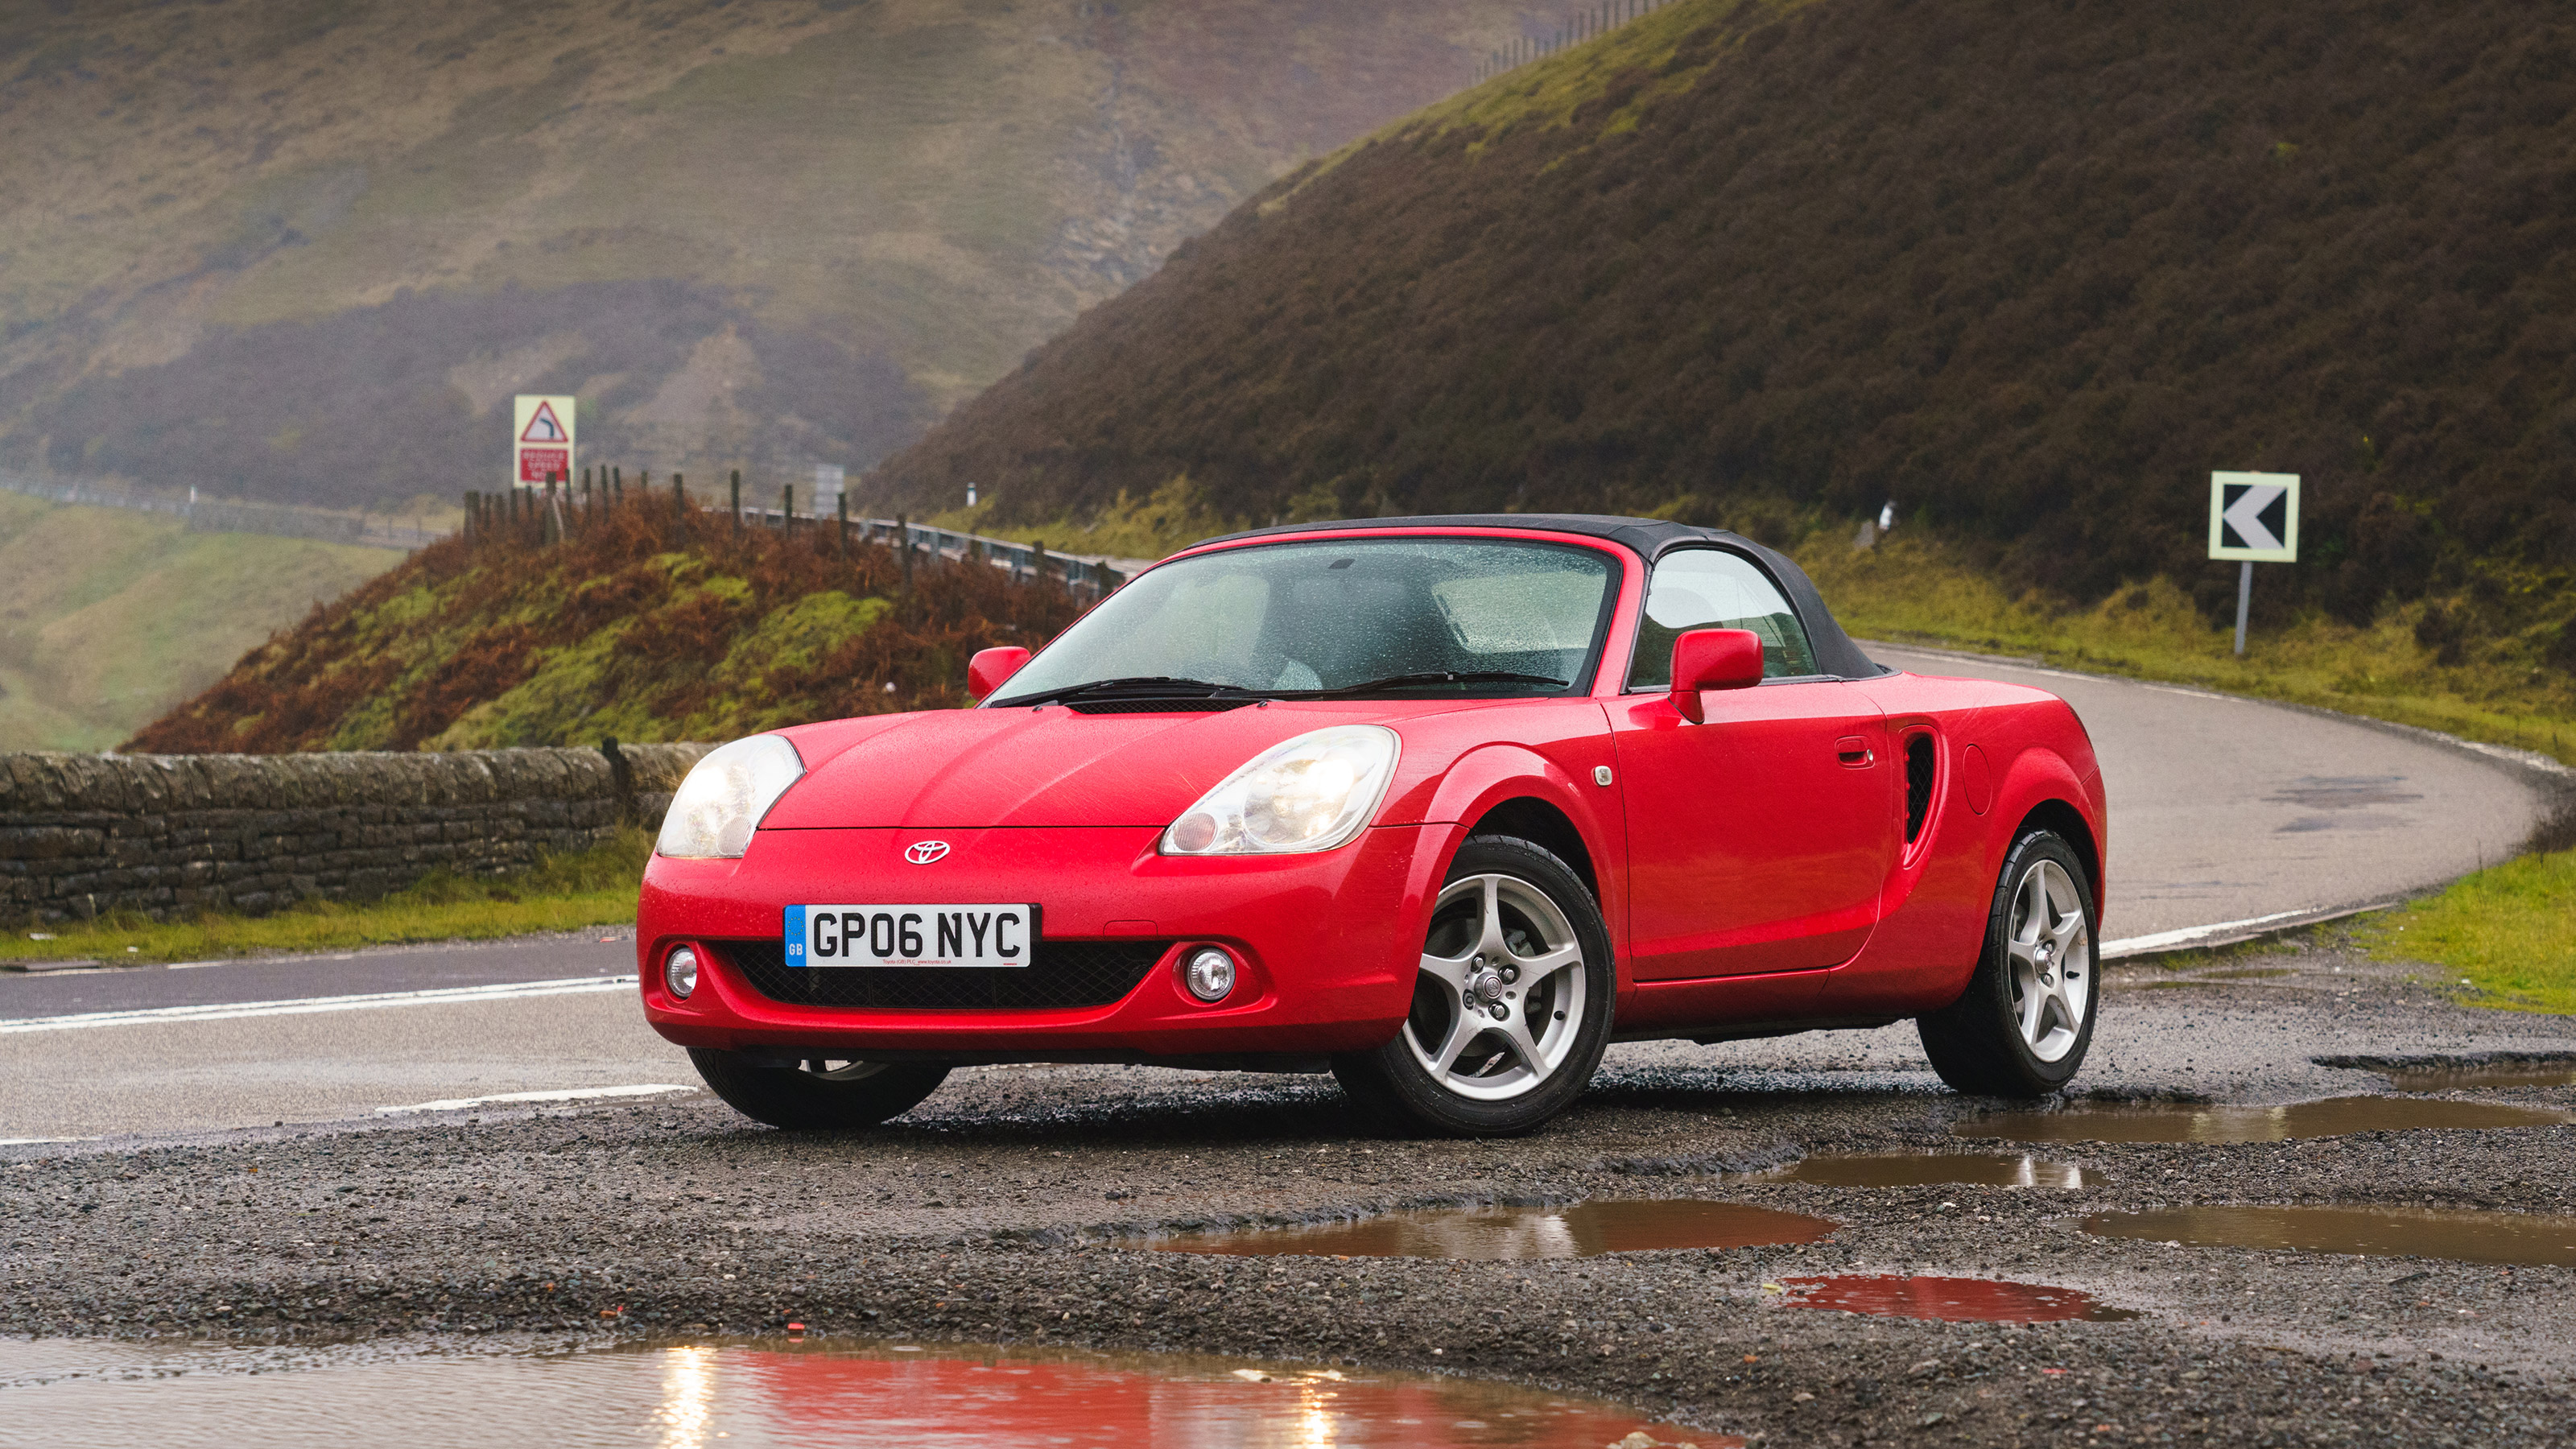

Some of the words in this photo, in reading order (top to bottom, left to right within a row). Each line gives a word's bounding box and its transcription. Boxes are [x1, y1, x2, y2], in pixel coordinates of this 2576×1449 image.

[789, 943, 803, 956] GB
[813, 912, 923, 958] GP06
[937, 912, 1021, 958] NYC
